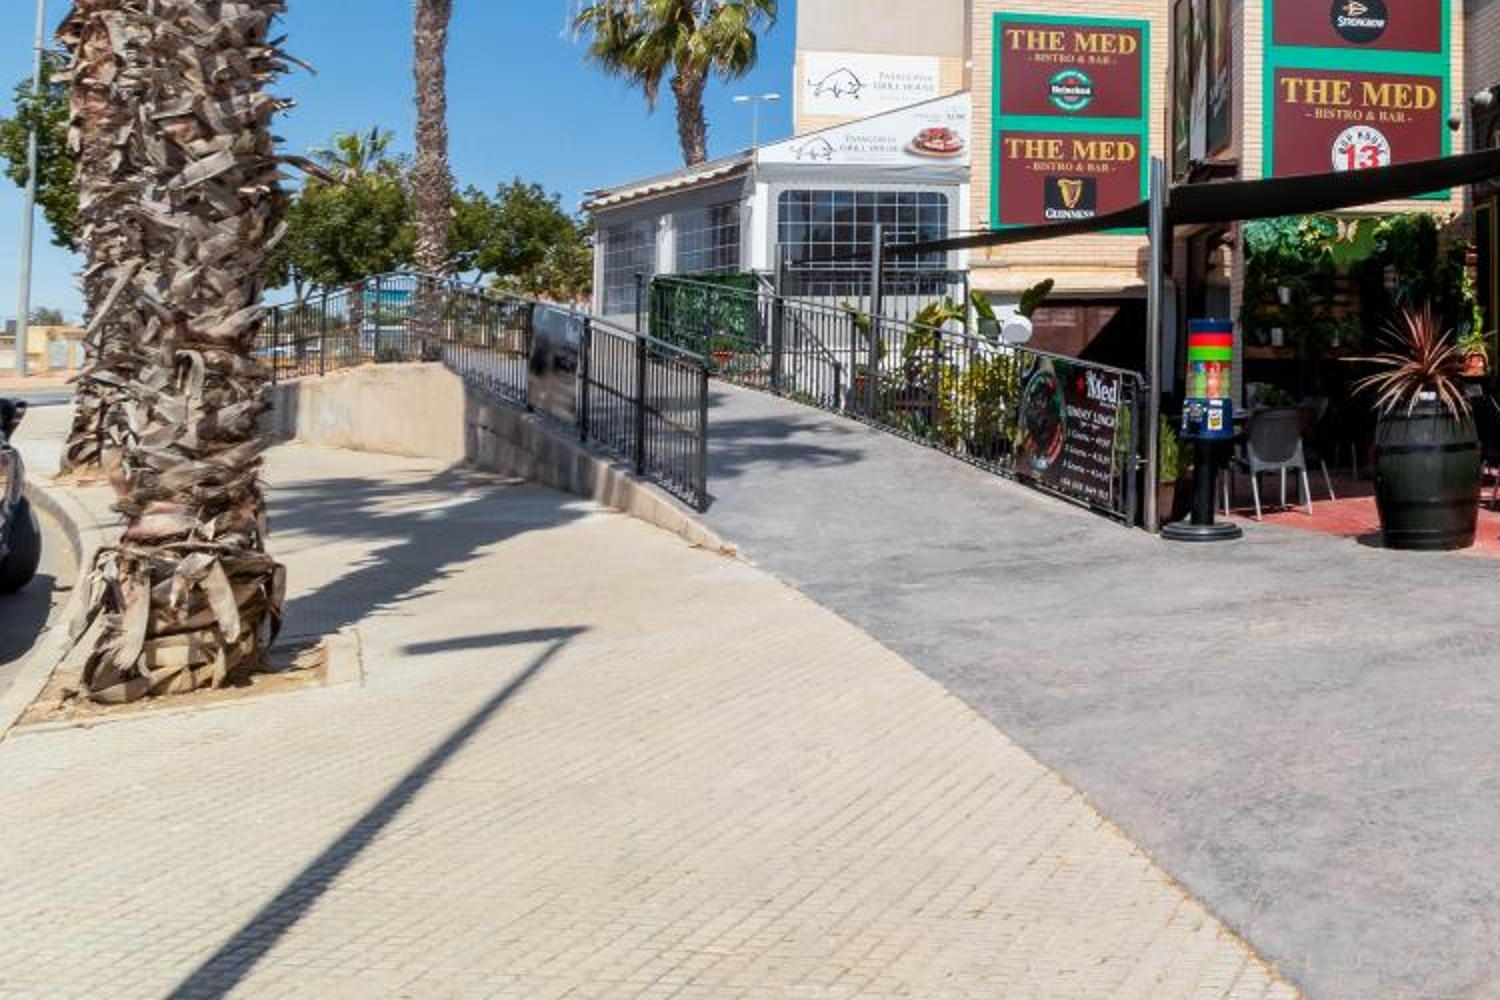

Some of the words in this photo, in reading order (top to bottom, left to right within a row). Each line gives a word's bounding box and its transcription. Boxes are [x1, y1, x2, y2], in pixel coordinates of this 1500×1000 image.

[1007, 29, 1065, 51] THE
[1075, 32, 1137, 54] MED
[1035, 53, 1075, 63] BISTRO
[1281, 78, 1352, 105] THE
[1361, 81, 1437, 109] MED
[1315, 108, 1362, 121] BISTRO
[1379, 110, 1405, 122] BAR
[1006, 138, 1064, 159] THE
[1072, 140, 1136, 161] MED
[1345, 143, 1378, 170] 13
[1033, 162, 1073, 171] BISTRO
[1088, 163, 1110, 173] BAR
